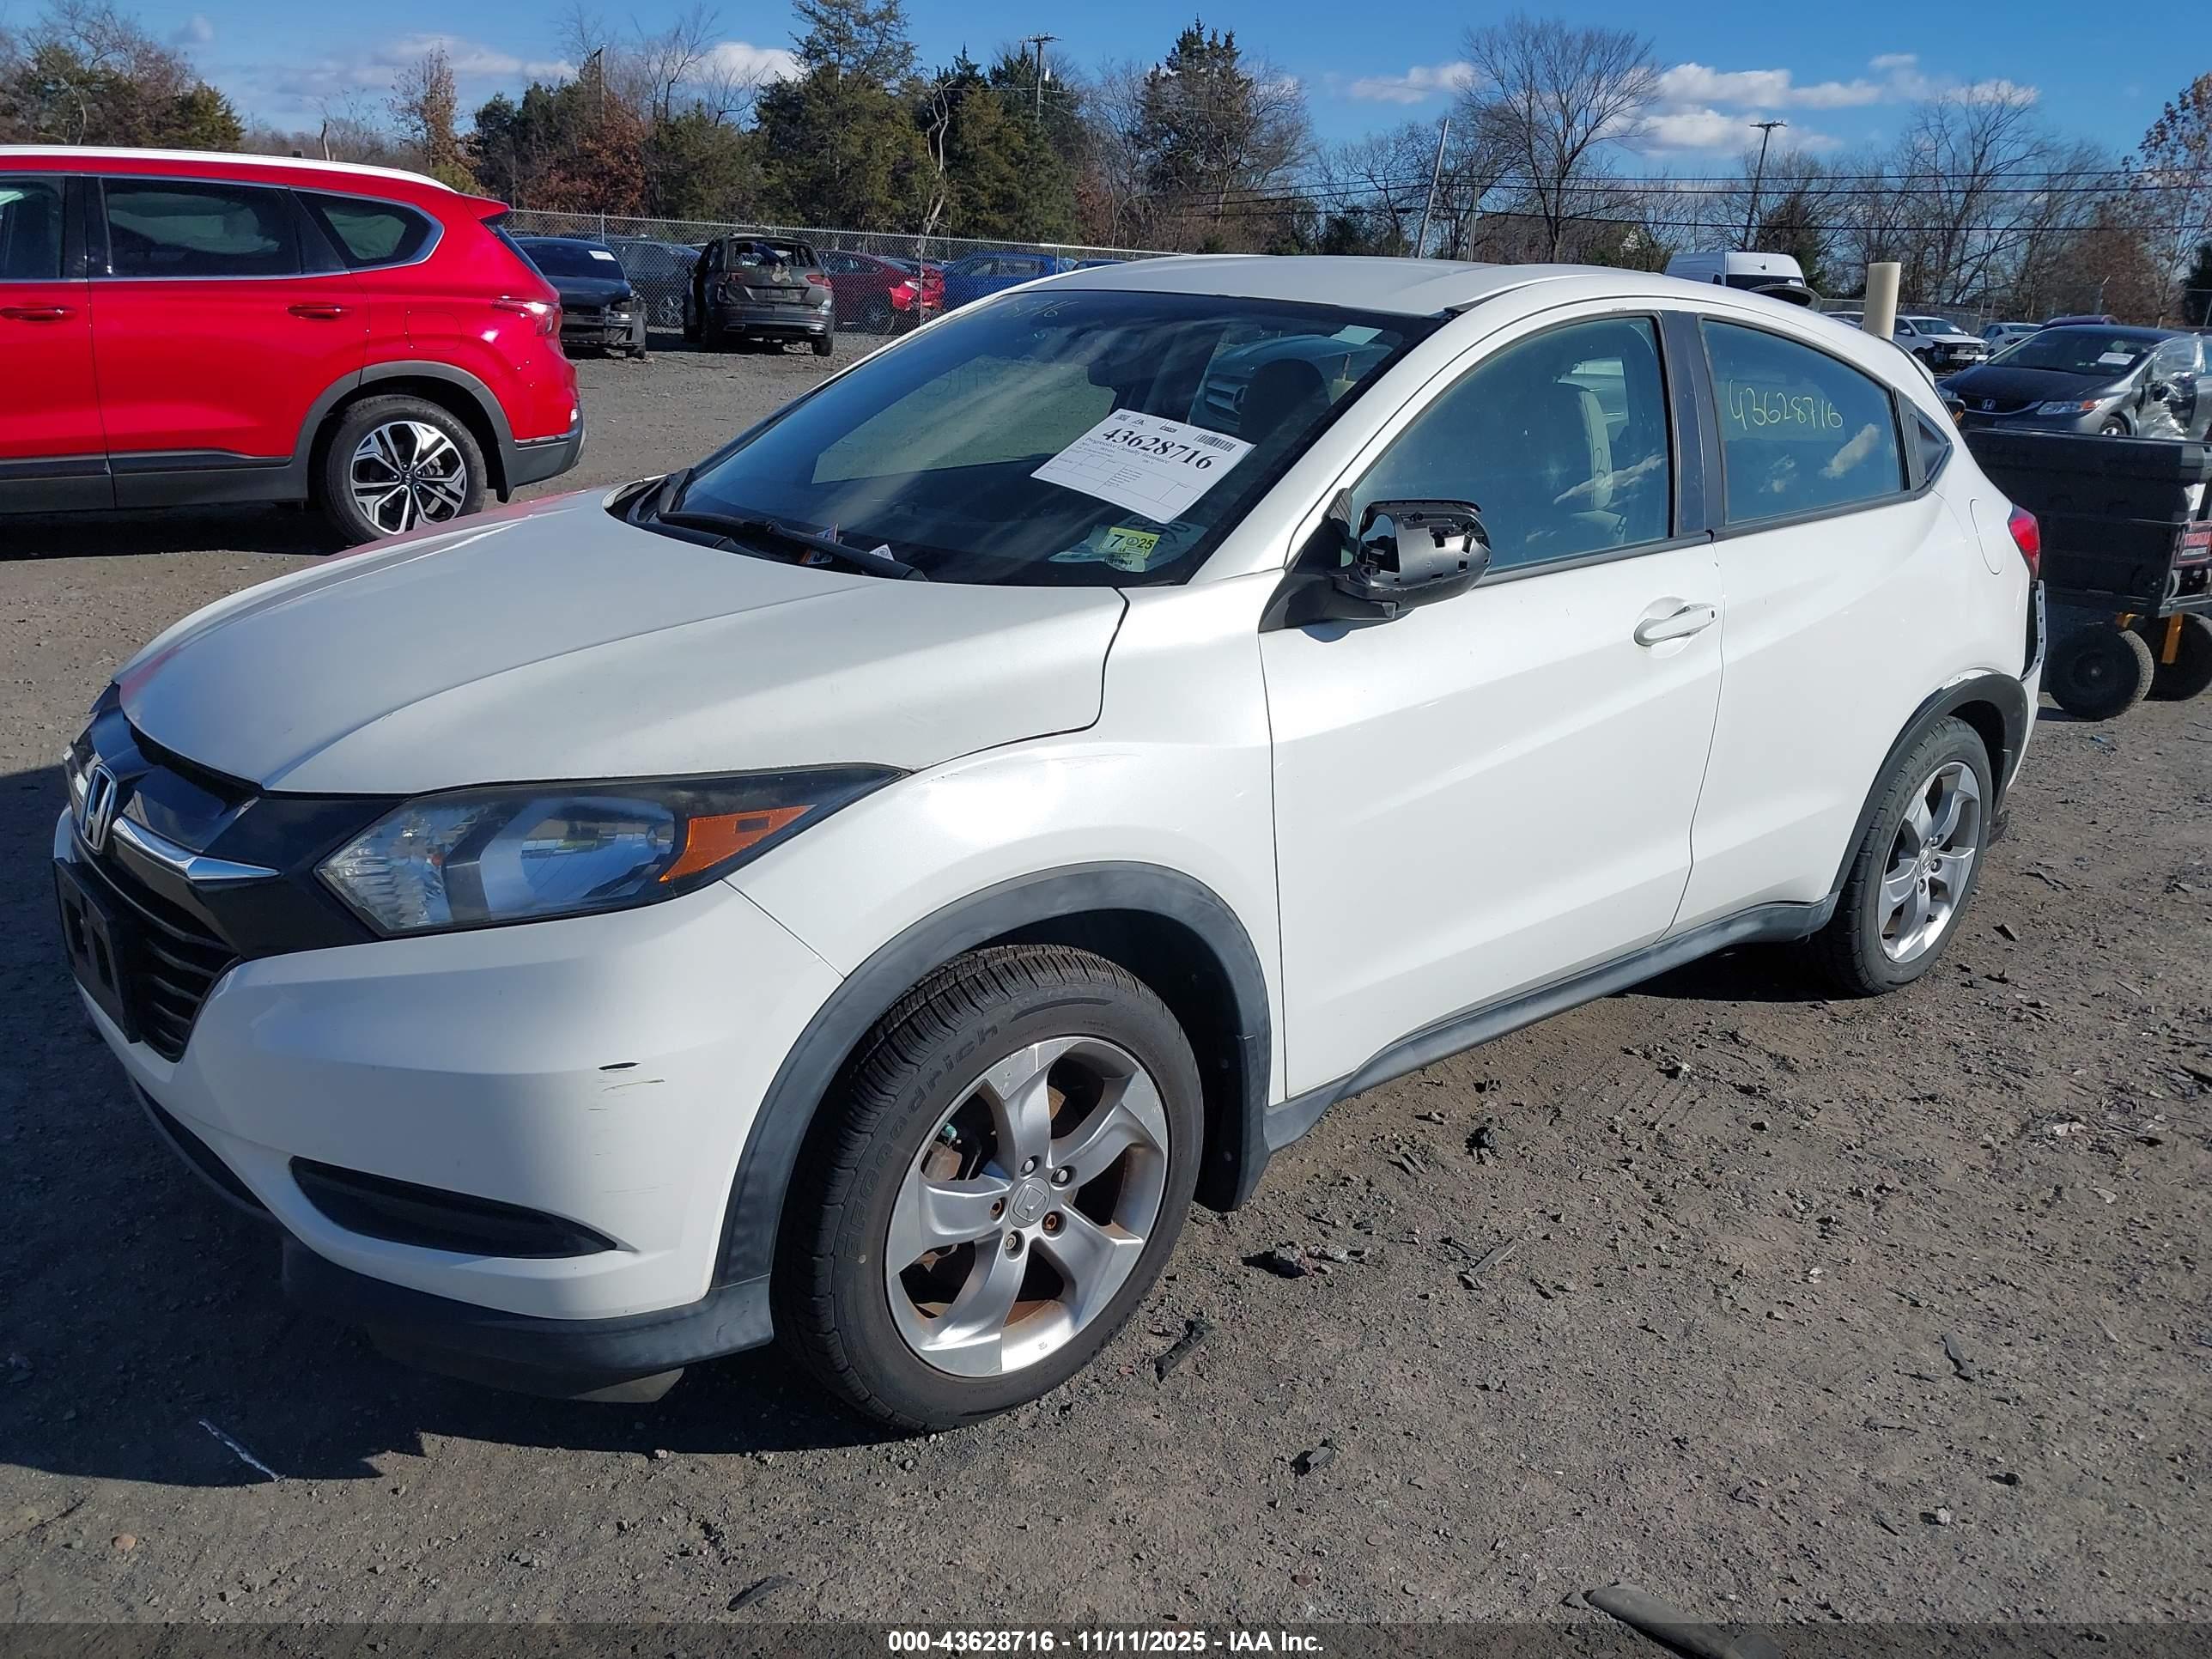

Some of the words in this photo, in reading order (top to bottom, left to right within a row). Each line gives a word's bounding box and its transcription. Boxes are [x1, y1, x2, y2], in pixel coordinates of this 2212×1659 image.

[1729, 379, 1844, 432] 43628716
[1102, 428, 1220, 470] 43628716
[1109, 534, 1125, 548] 7
[1137, 538, 1155, 550] 25
